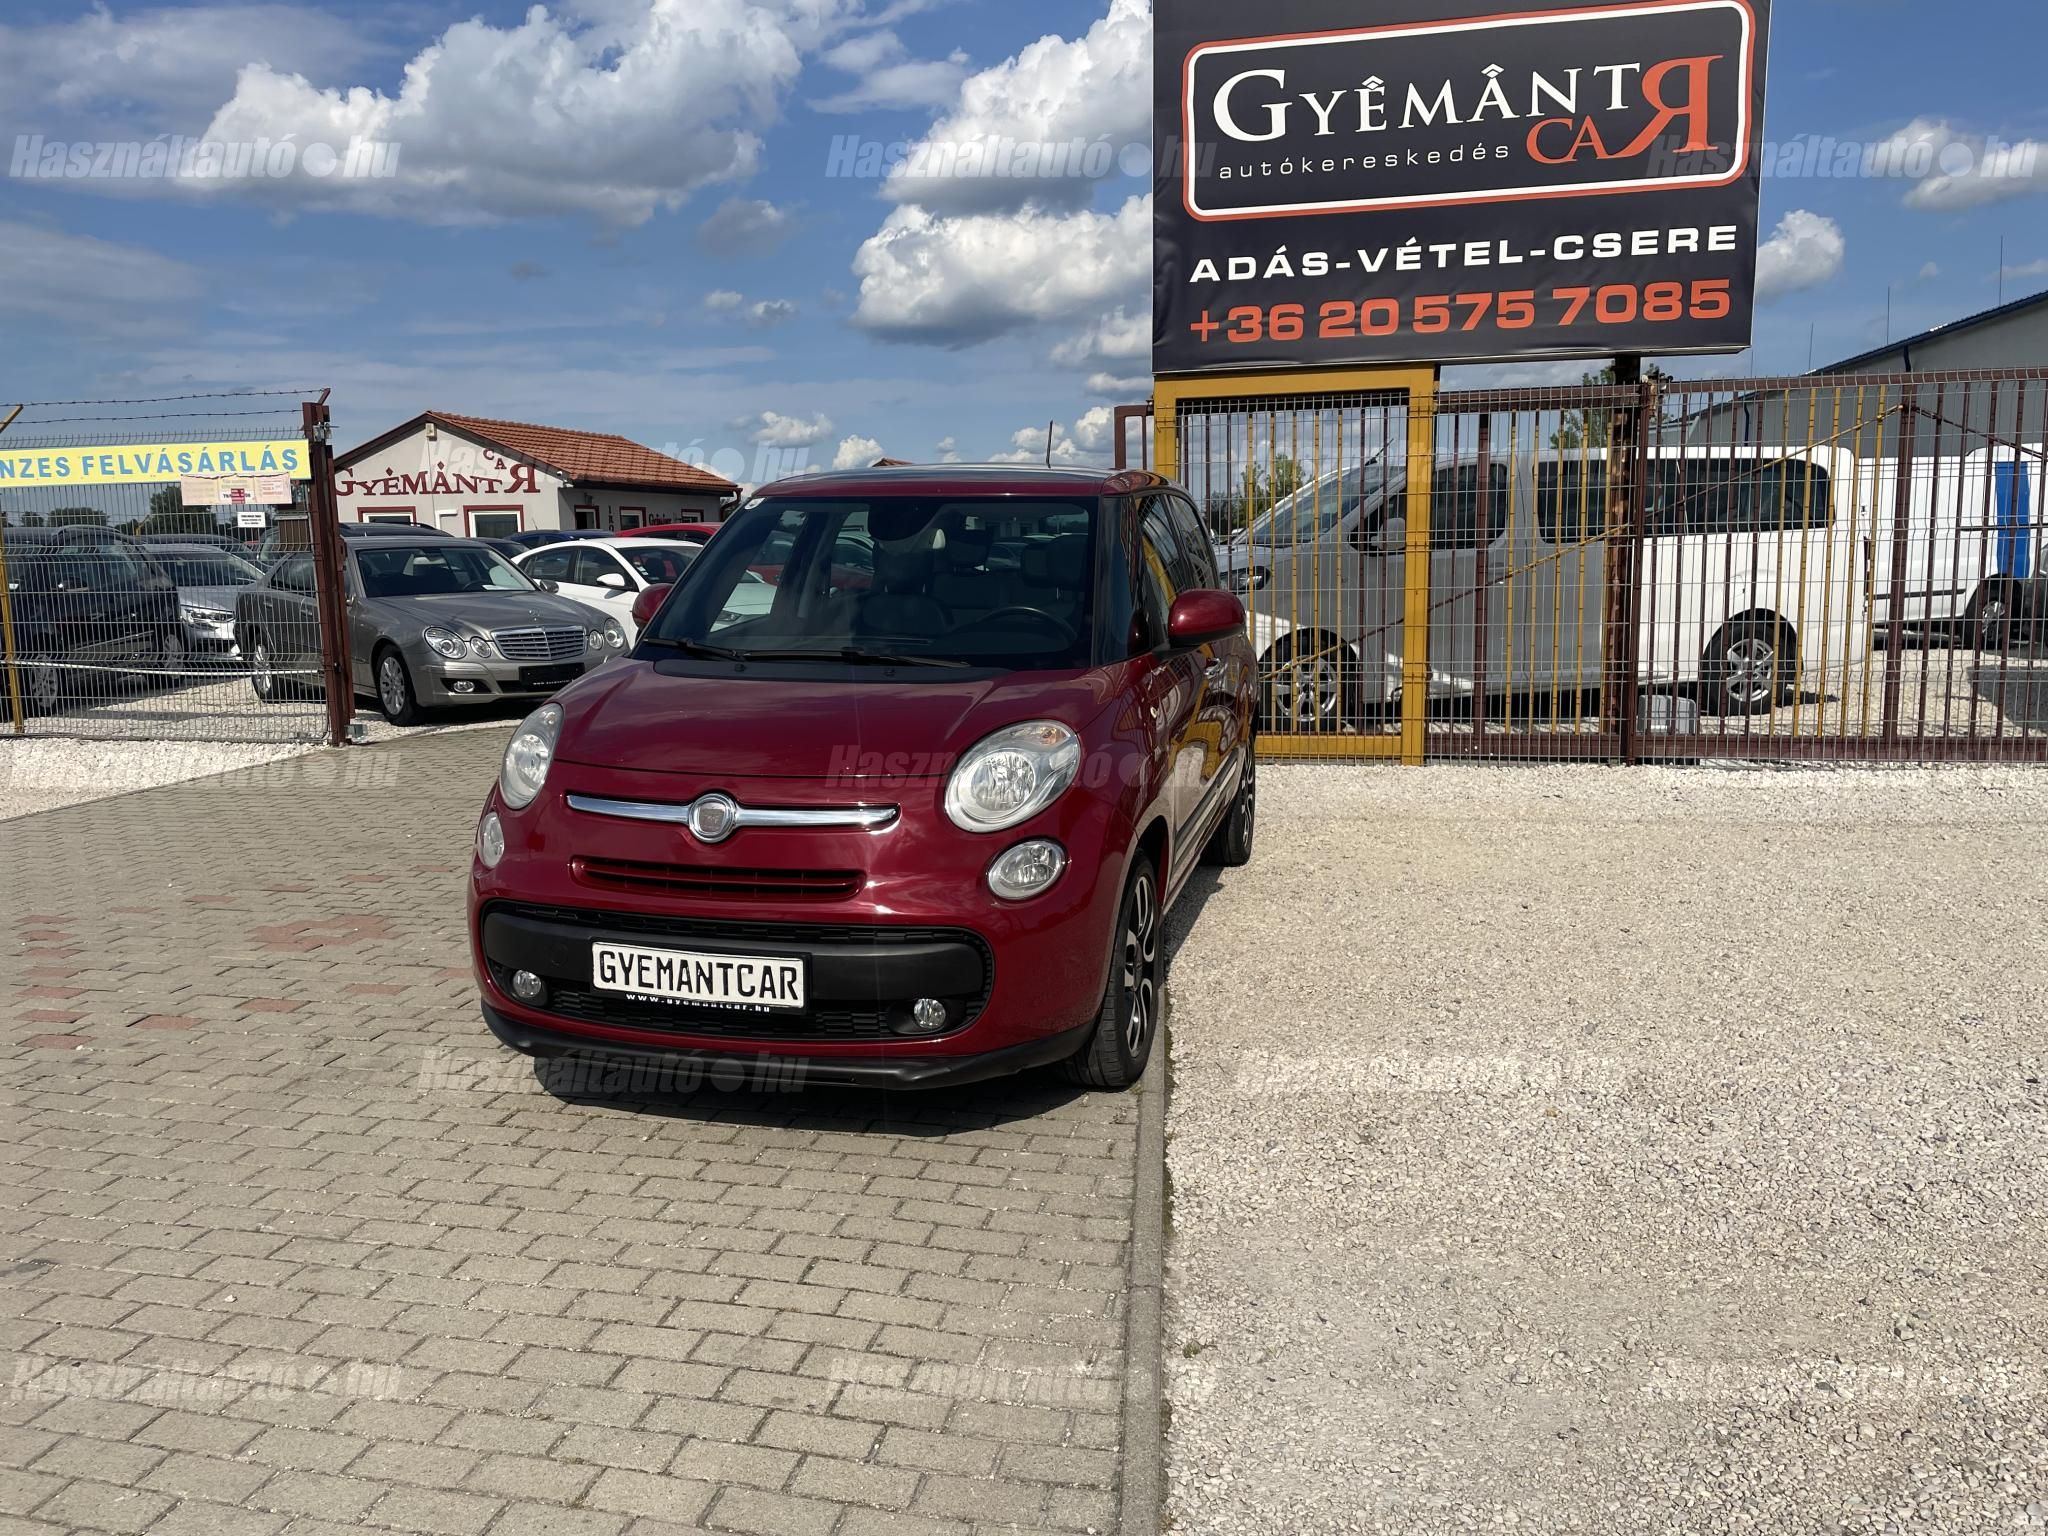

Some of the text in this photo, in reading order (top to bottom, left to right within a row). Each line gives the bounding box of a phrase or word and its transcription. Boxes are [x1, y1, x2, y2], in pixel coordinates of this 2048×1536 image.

[1219, 143, 1510, 180] autókereskedés
[1189, 224, 1737, 283] ADÁS-VÉTEL-CSERE
[1190, 279, 1731, 343] +36 20 575 7085
[0, 445, 298, 479] NZES FELVÁSÁRLÁS
[600, 950, 798, 1000] GYEMANTCAR
